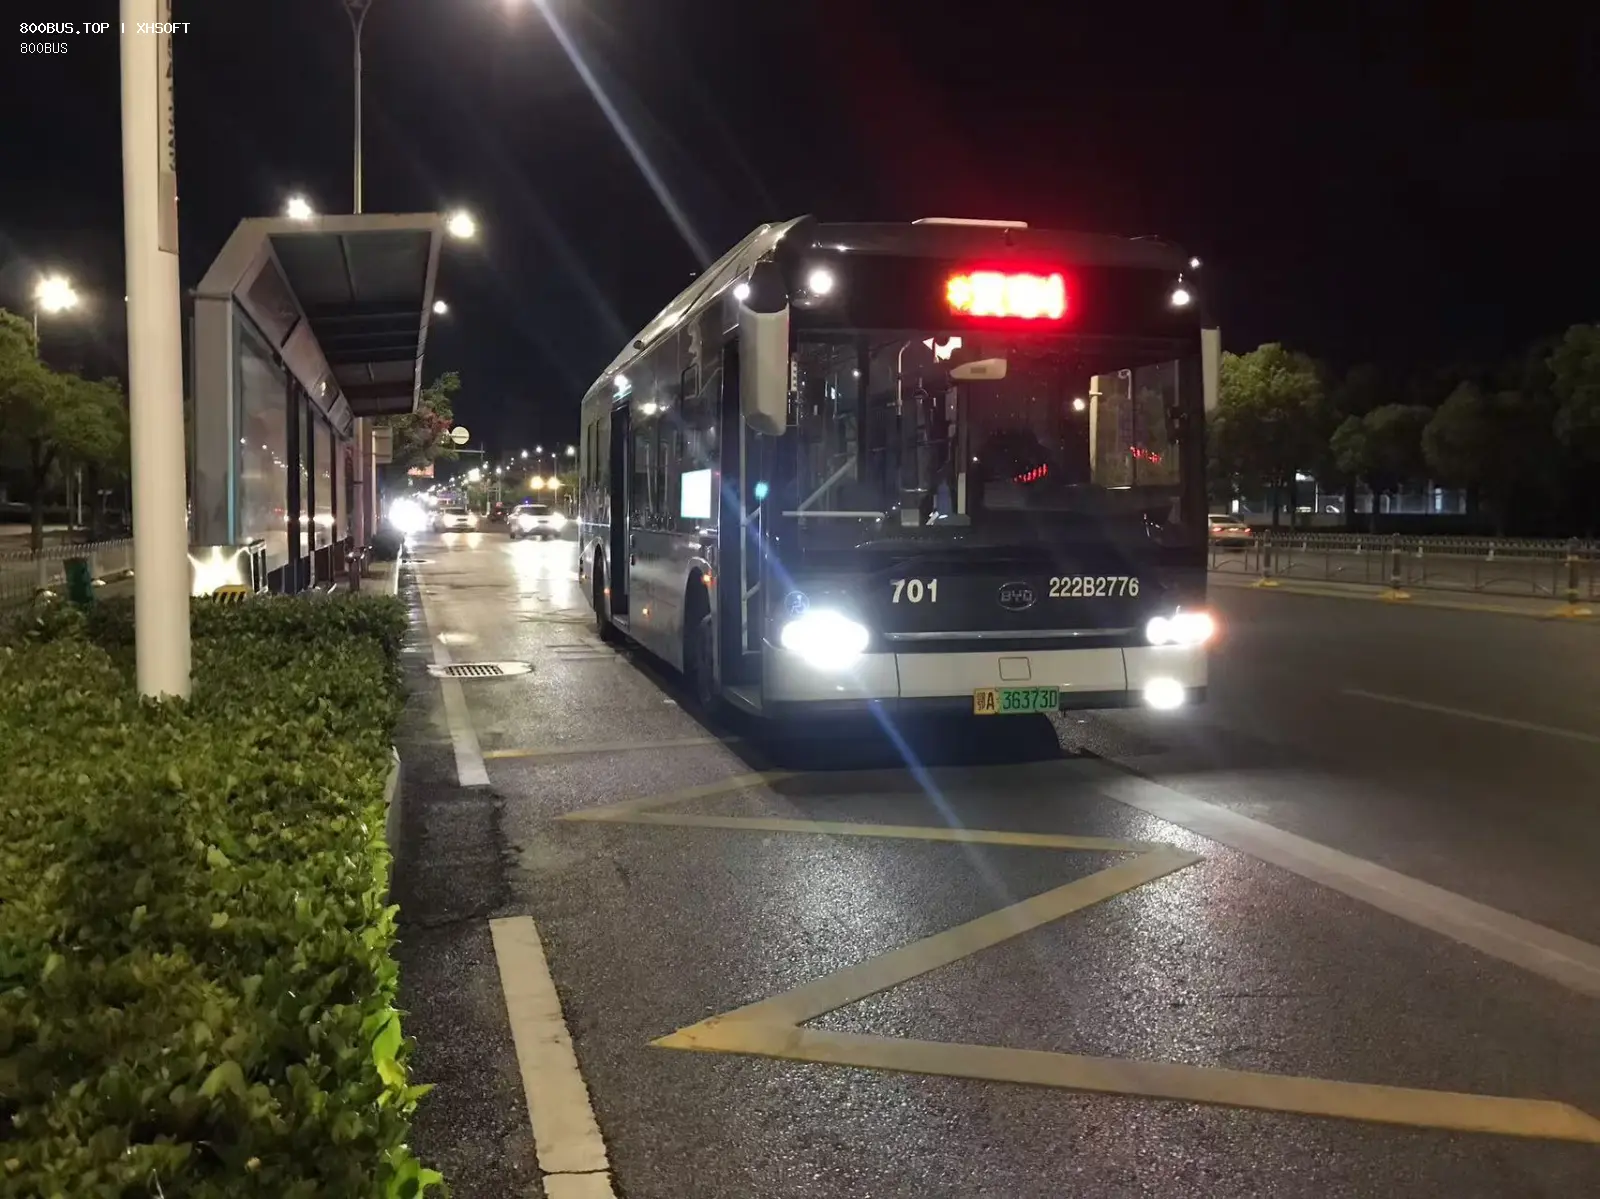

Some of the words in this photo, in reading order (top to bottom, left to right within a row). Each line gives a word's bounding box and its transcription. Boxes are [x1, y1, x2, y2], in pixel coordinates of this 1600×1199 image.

[890, 578, 938, 604] 701
[1000, 589, 1033, 603] BYD
[1049, 576, 1140, 598] 222B2776
